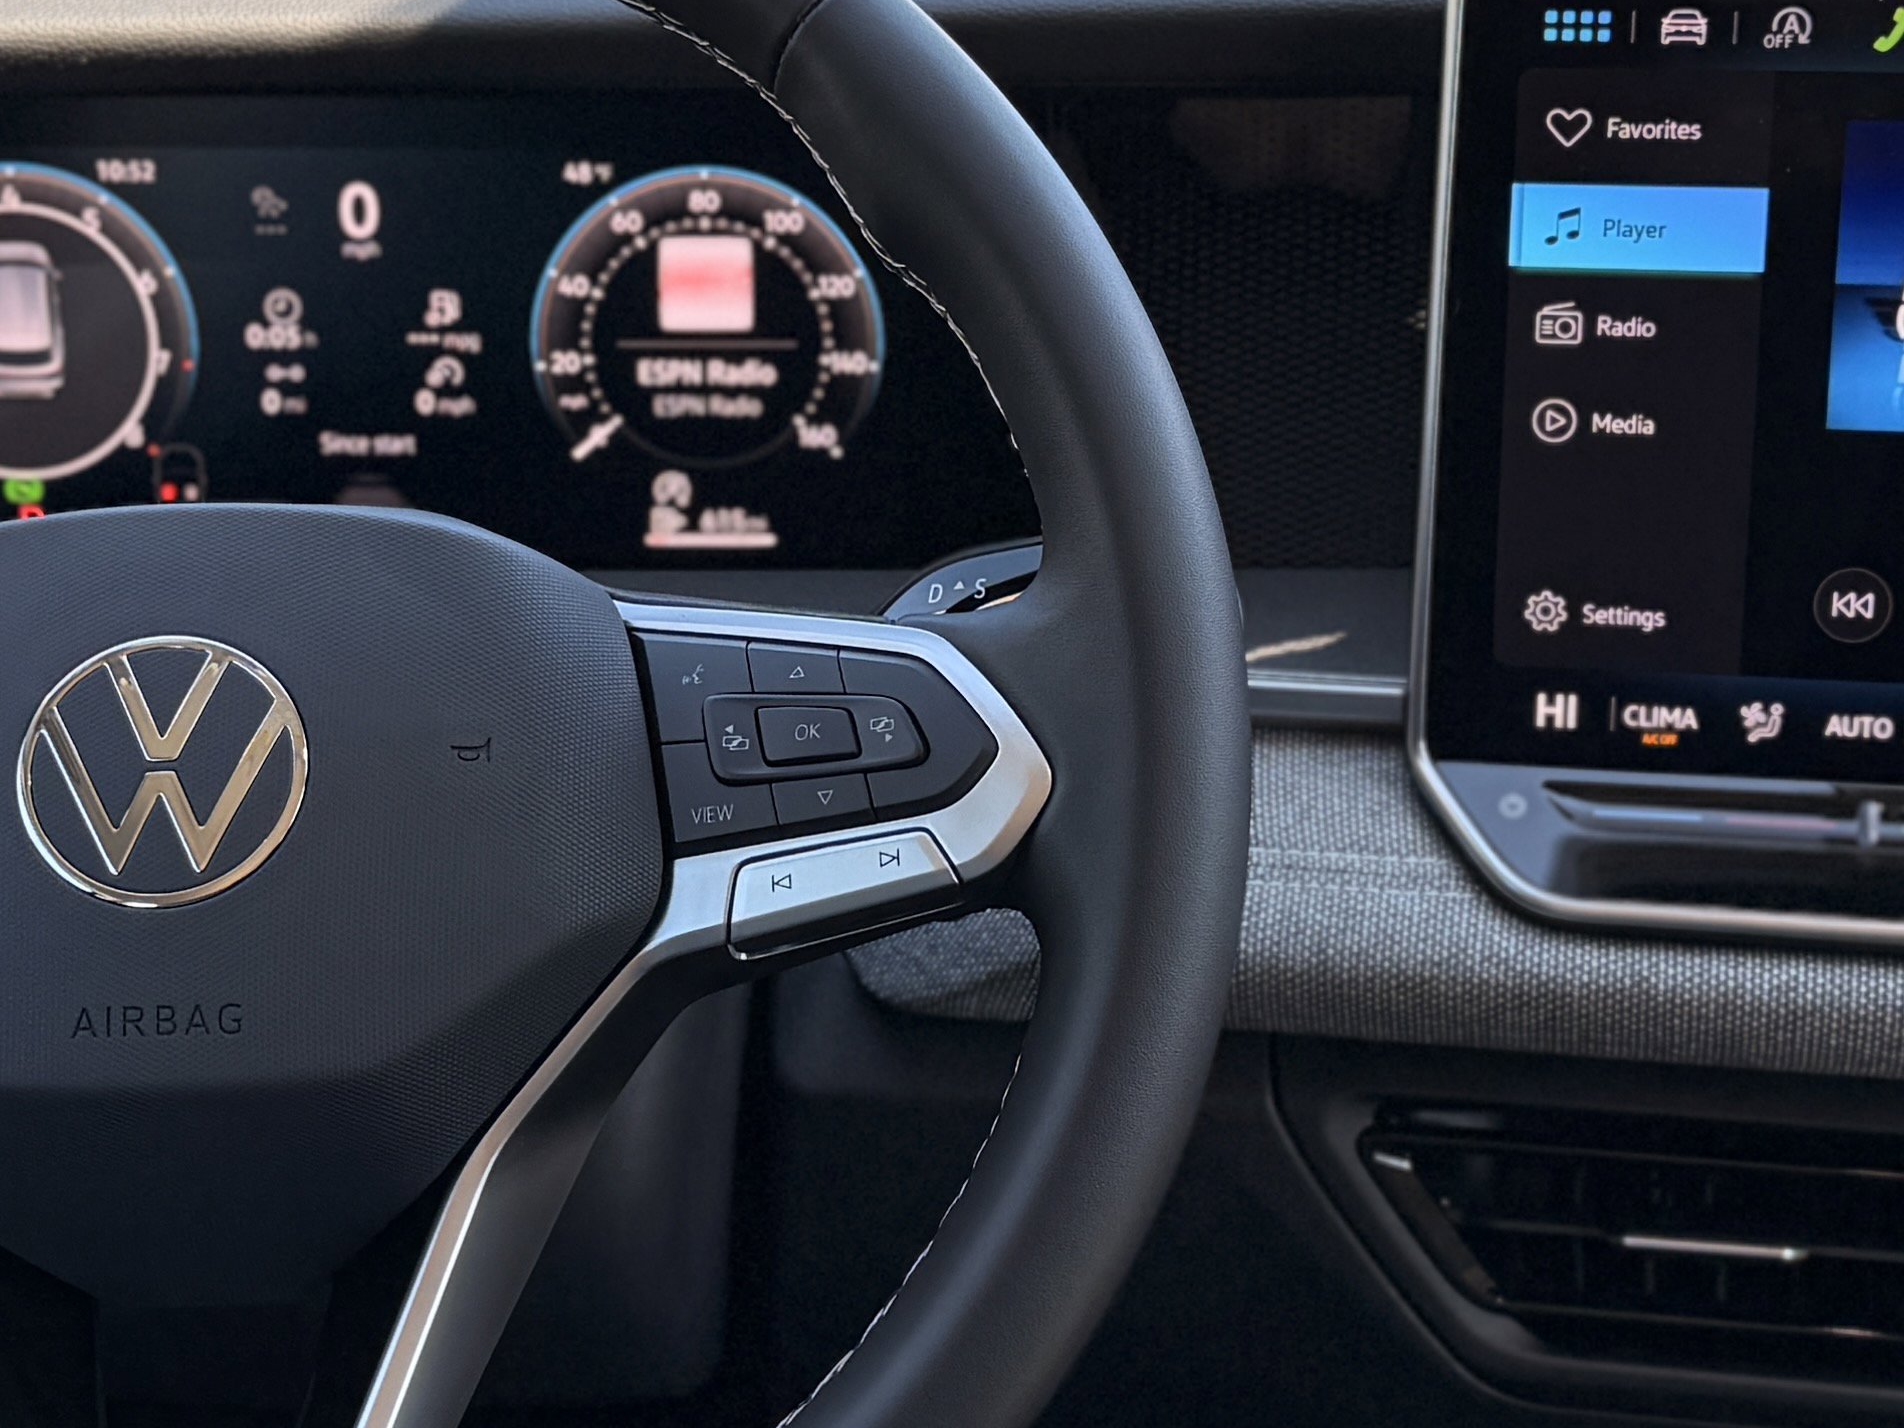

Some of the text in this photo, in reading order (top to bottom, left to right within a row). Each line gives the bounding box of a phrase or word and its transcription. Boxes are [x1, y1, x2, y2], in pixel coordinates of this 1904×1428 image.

[1763, 34, 1794, 49] OFF
[1606, 117, 1703, 141] Favorites
[95, 159, 157, 183] 10:52
[338, 180, 381, 239] 0
[687, 190, 722, 215] 80
[610, 209, 644, 235] 60
[763, 211, 806, 234] 100
[1602, 216, 1668, 245] Player
[557, 275, 591, 299] 40
[818, 274, 856, 298] 120
[1596, 314, 1658, 339] Radio
[550, 352, 582, 375] 20
[636, 358, 778, 388] ESPN Radio
[828, 352, 869, 376] 140
[651, 393, 764, 419] ESPN Radio
[1591, 412, 1656, 437] Media
[798, 425, 839, 449] 160
[927, 583, 944, 604] D
[973, 577, 988, 599] S
[1582, 603, 1667, 633] Settings
[1535, 692, 1699, 731] HI CLIMA
[794, 722, 822, 741] OK
[1824, 714, 1895, 741] AUTO
[690, 804, 735, 825] VIEW
[70, 1002, 245, 1041] AIRBAG
